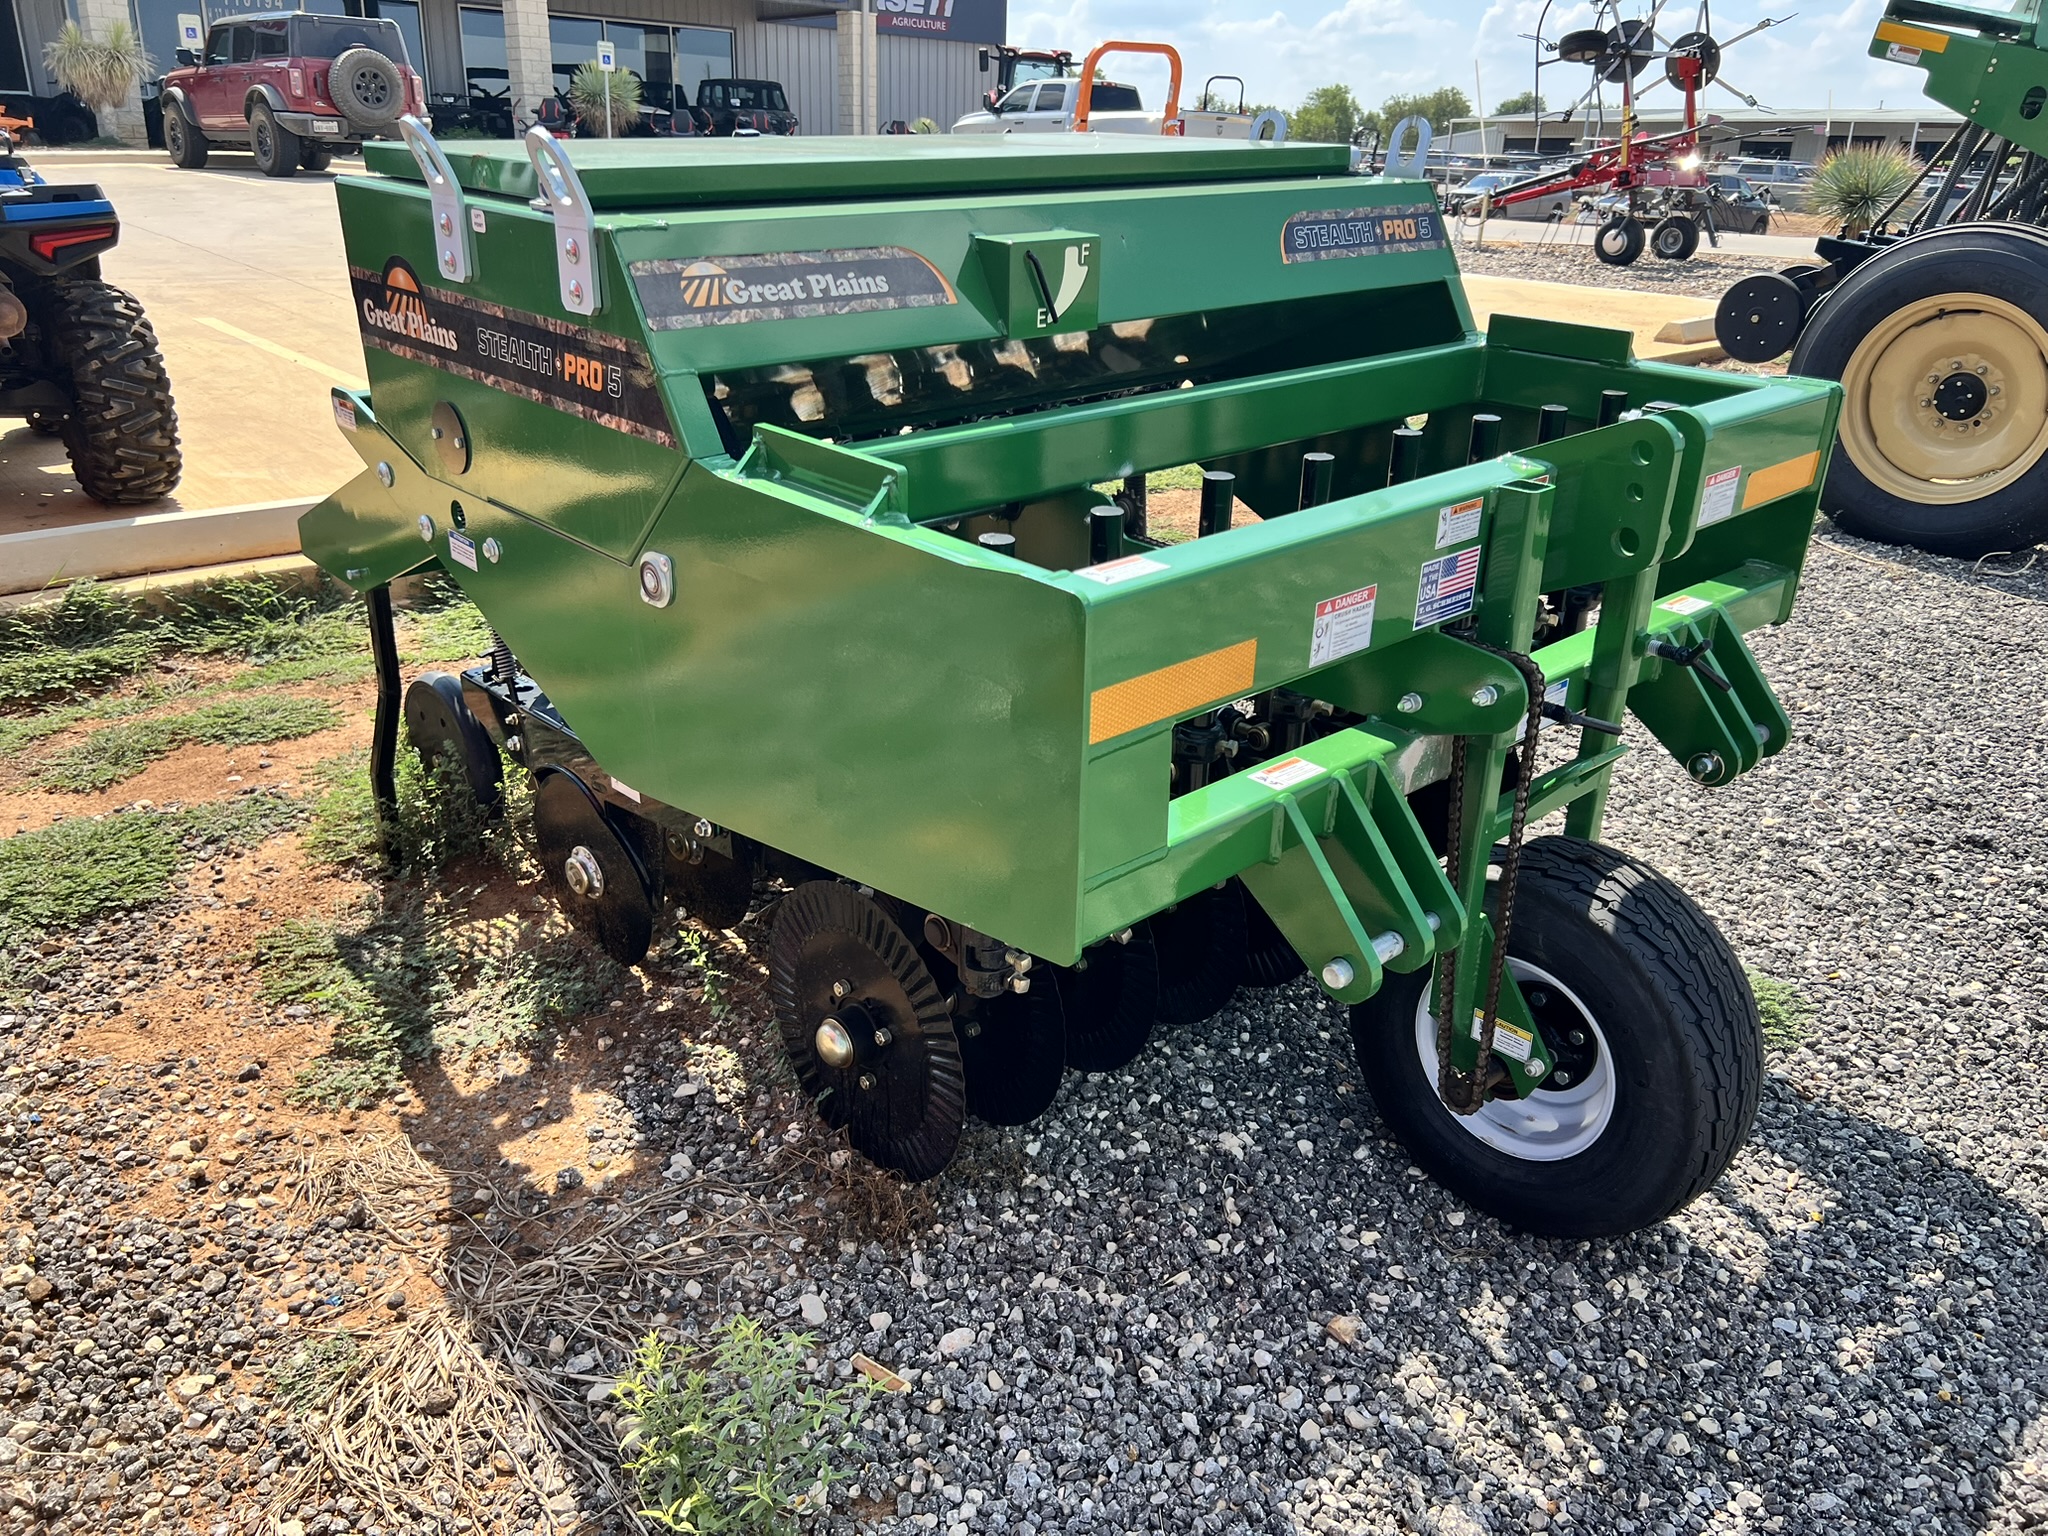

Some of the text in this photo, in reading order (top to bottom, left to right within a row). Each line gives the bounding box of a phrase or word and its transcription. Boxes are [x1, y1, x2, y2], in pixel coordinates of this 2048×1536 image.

[891, 16, 947, 31] AGRICULTURE
[1293, 217, 1431, 249] STEALTH PRO 5
[1081, 243, 1090, 264] F
[725, 271, 889, 305] Great Plains
[363, 298, 459, 352] Great Plains
[1037, 308, 1047, 328] E
[476, 327, 622, 399] STEALTH PRO 5
[1423, 562, 1440, 574] MADE
[1335, 590, 1369, 610] DANGER
[1420, 583, 1437, 601] USA
[1334, 602, 1372, 620] CRUSH HAZARD
[1494, 1020, 1518, 1035] CAUTION
